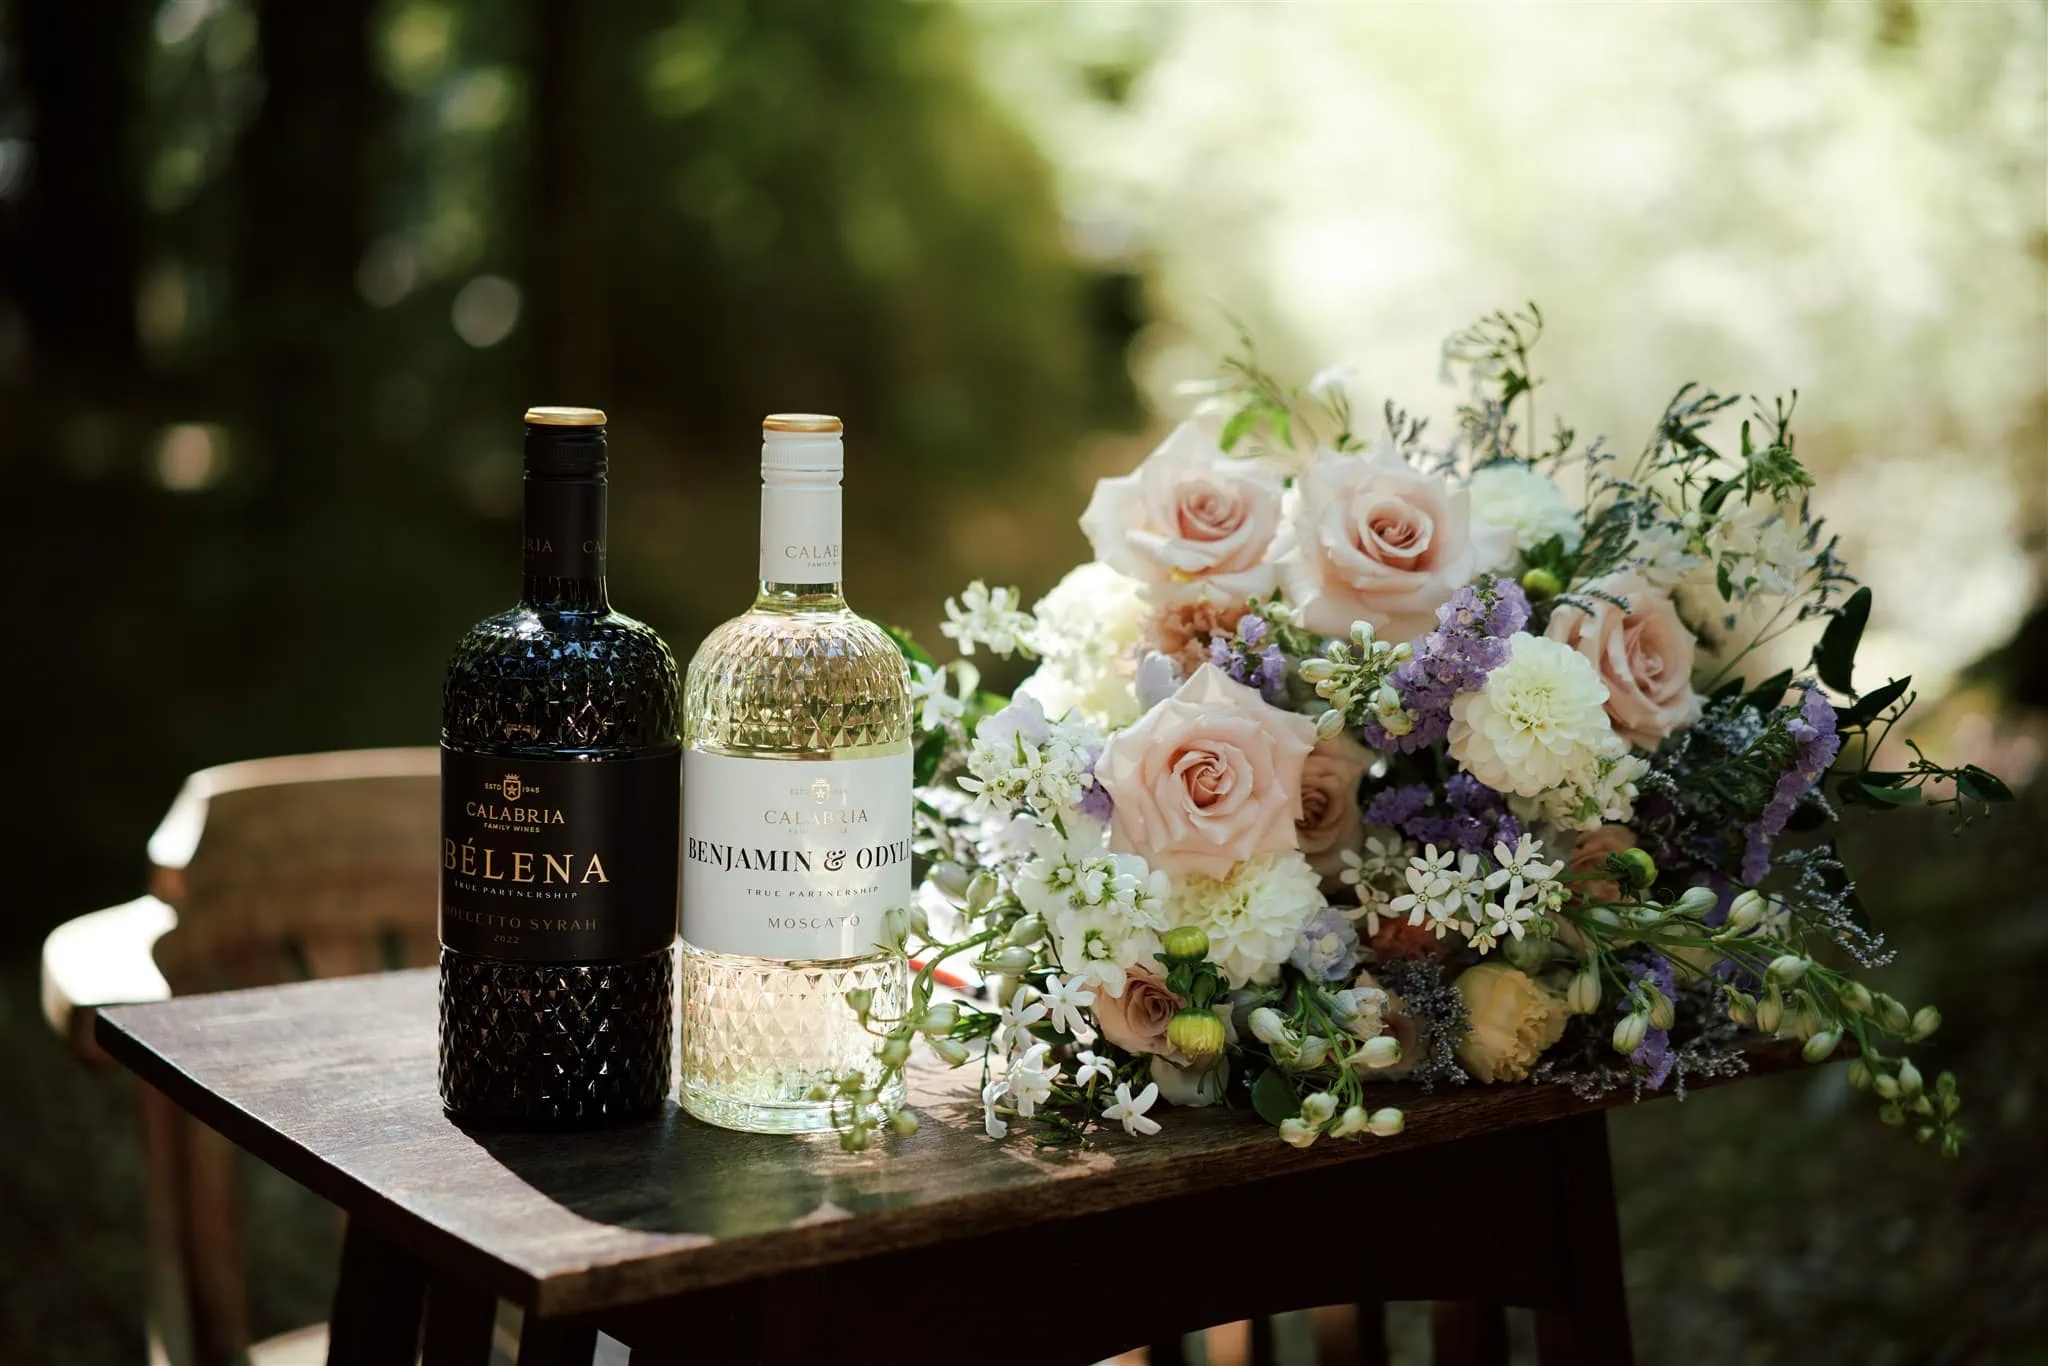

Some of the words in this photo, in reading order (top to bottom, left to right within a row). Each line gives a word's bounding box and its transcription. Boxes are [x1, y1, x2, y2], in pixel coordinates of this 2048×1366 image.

[484, 782, 502, 791] ESTD
[466, 801, 565, 824] CALABRIA
[764, 809, 869, 825] CALABRIA
[484, 822, 510, 831] FAMILY
[513, 825, 540, 833] WINES
[444, 837, 610, 884] BÉLENA
[689, 837, 812, 872] BENJAMIN
[823, 849, 846, 872] &
[454, 879, 478, 892] TRUE
[483, 886, 579, 899] PARTNERSHIP
[746, 888, 781, 897] TRUE
[789, 886, 879, 898] PARTNERSHIP
[530, 918, 597, 931] SYRAH
[768, 915, 861, 930] MOSCATO
[493, 934, 520, 944] 2022
